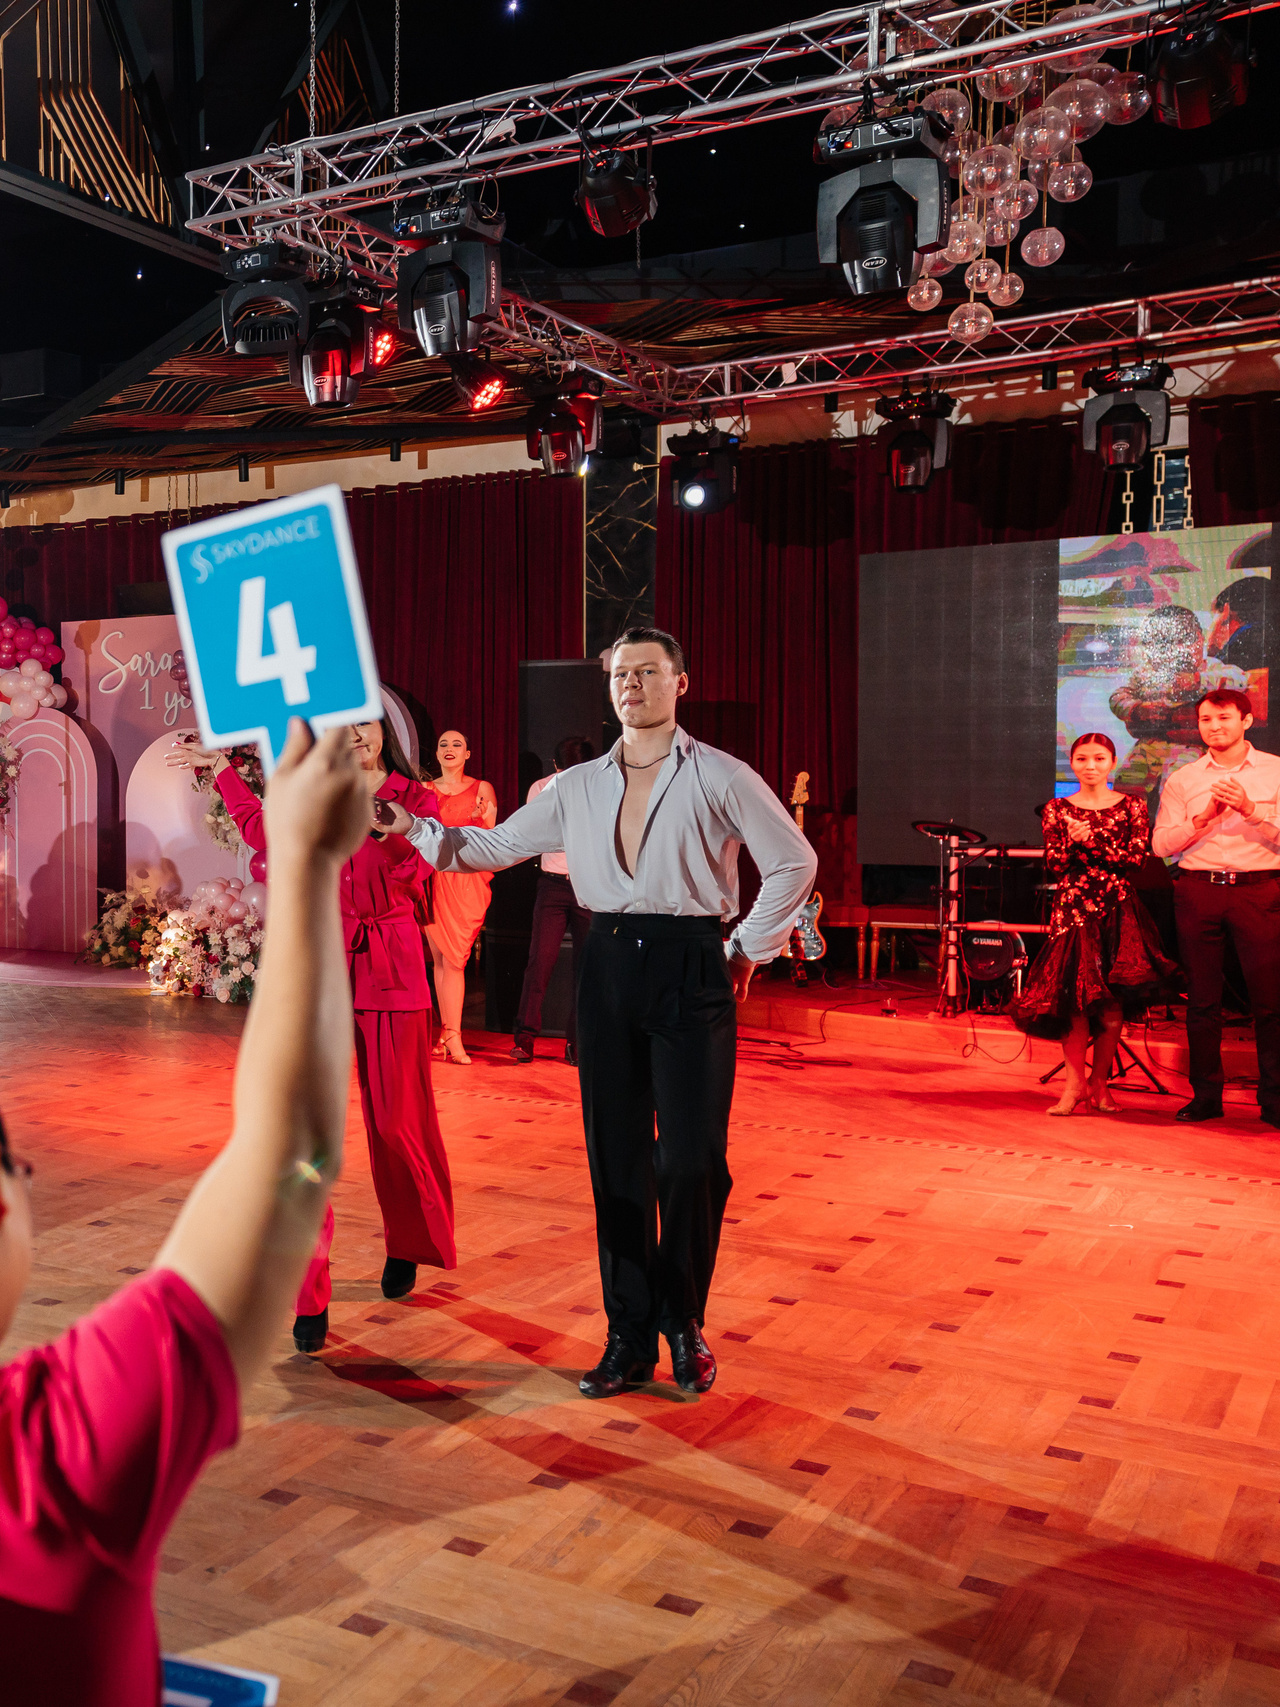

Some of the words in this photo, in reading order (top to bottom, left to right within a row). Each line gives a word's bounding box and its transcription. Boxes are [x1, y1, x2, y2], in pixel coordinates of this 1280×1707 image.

[865, 259, 885, 267] BEAM
[211, 515, 320, 564] SKYDANCE
[236, 576, 317, 706] 4
[140, 679, 155, 709] 1
